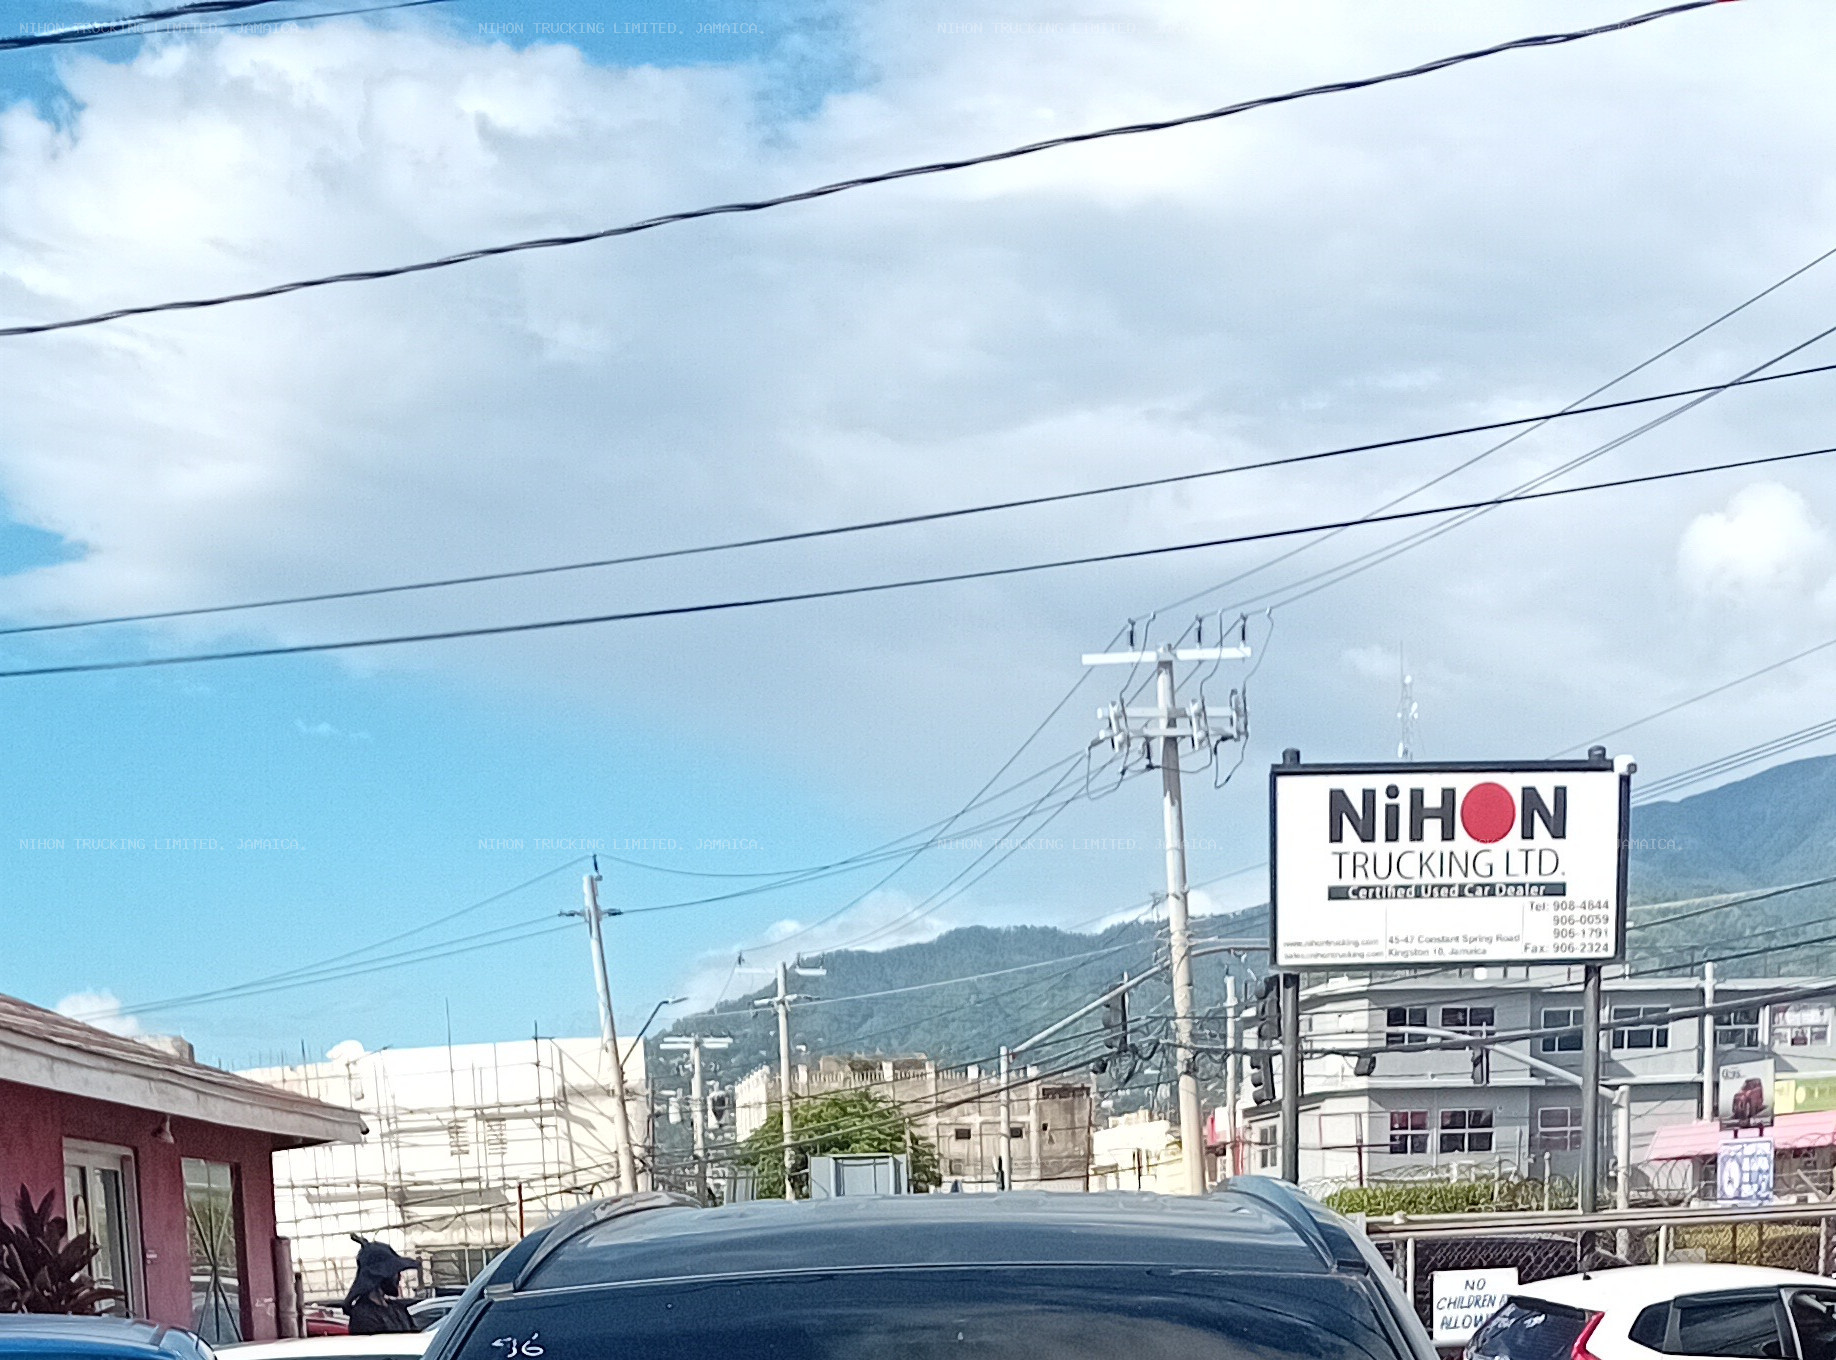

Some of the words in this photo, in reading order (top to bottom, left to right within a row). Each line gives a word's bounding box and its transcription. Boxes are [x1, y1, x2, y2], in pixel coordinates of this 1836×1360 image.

[1331, 848, 1494, 881] TRUCKING
[1505, 848, 1567, 877] LTD.
[1347, 884, 1416, 899] Certified
[1421, 883, 1459, 898] Used
[1464, 883, 1490, 897] Car
[1495, 882, 1546, 897] Dealer
[1462, 934, 1493, 945] Spring
[1495, 934, 1521, 942] Road
[1388, 948, 1429, 958] Kingston
[1464, 1278, 1486, 1291] NO
[1436, 1294, 1497, 1311] CHILDREN
